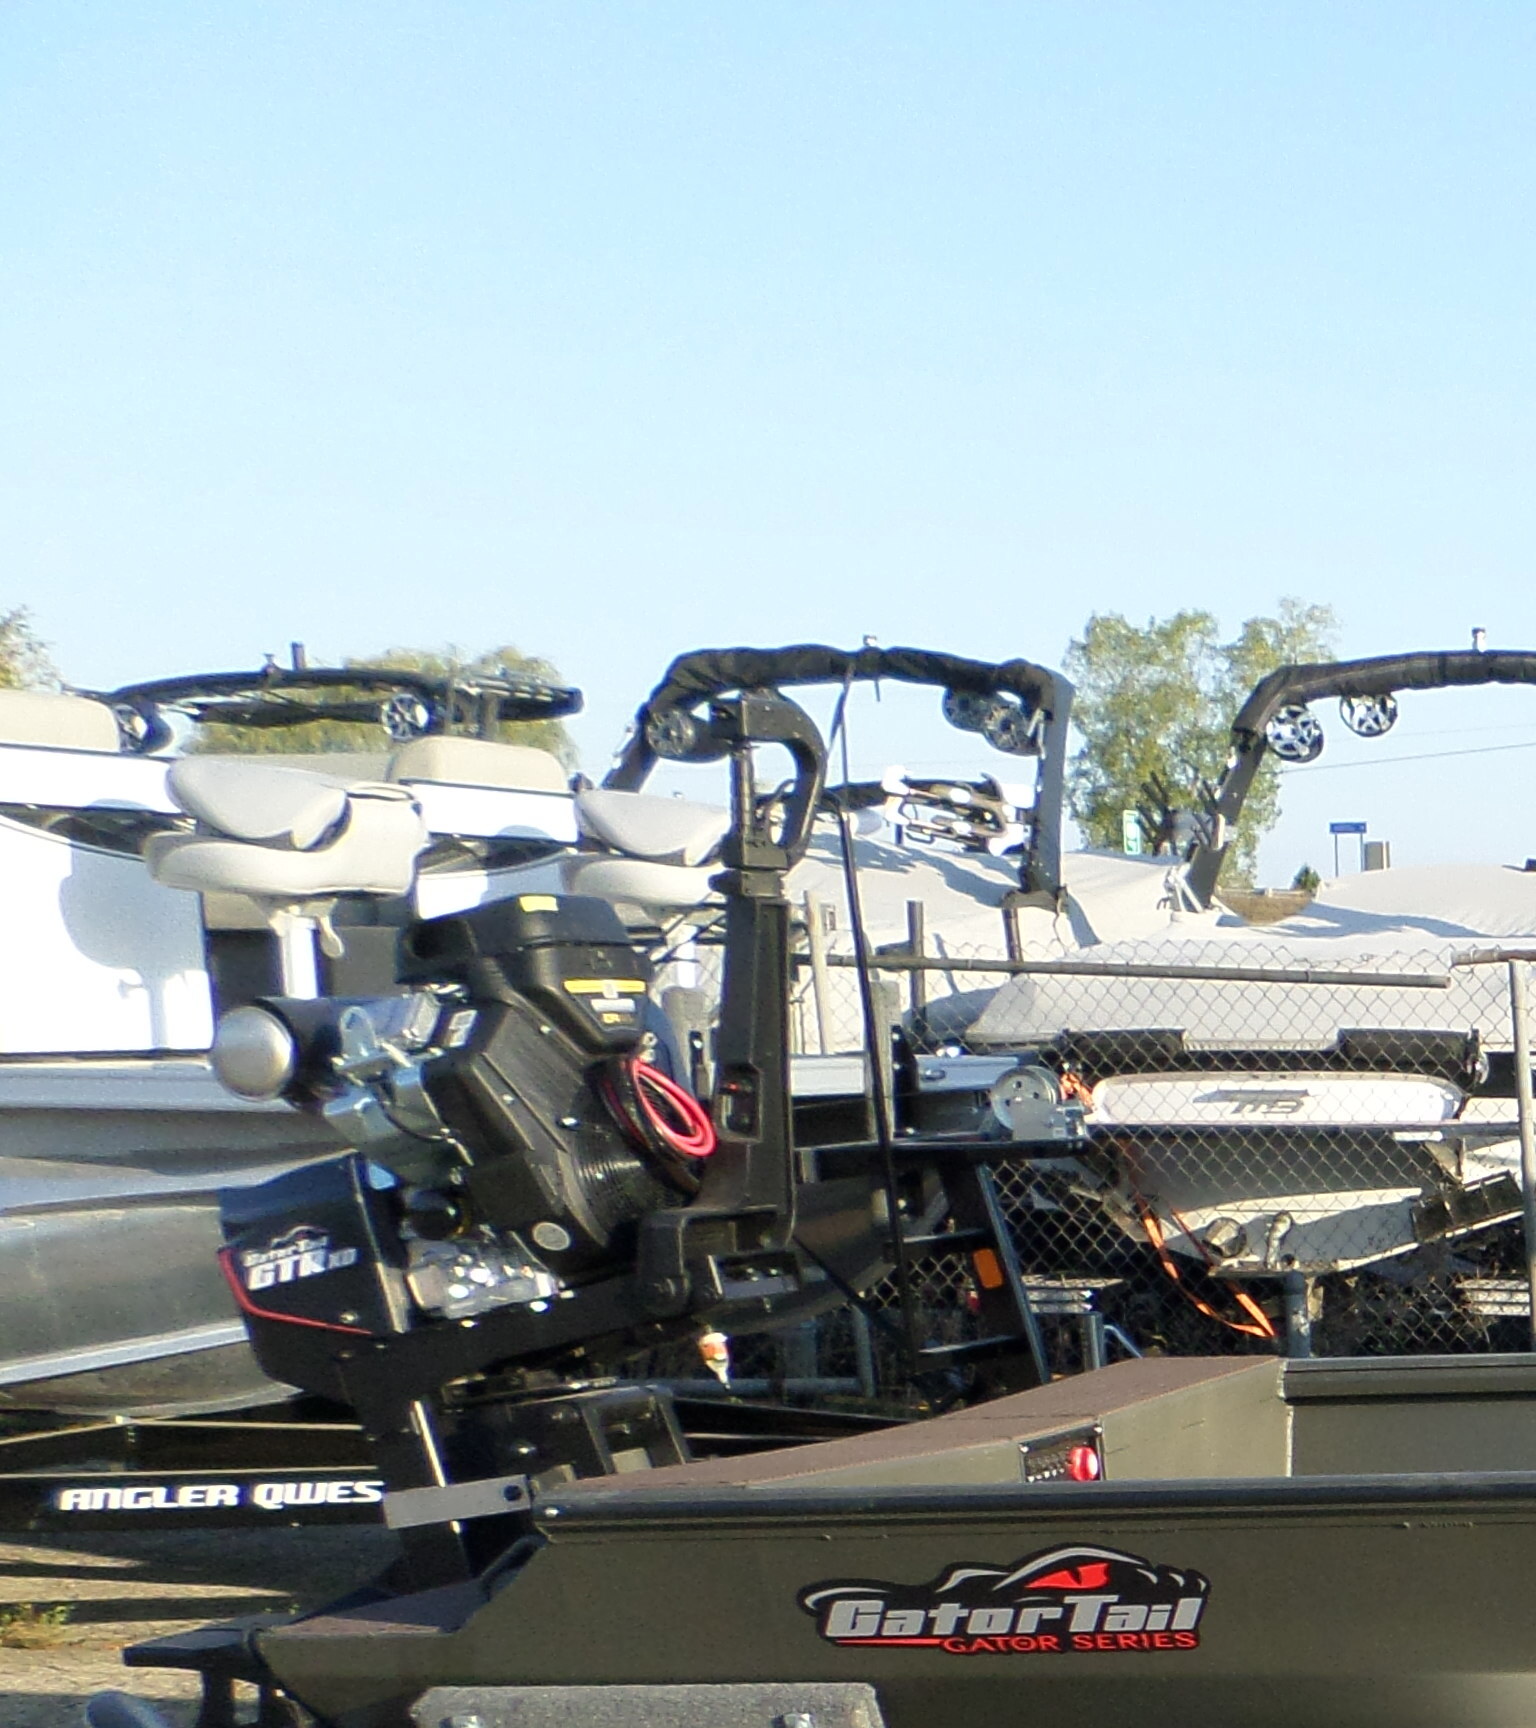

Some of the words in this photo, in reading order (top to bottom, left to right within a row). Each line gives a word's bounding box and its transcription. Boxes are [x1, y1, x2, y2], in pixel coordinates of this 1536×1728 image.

[59, 1484, 240, 1511] ANGLER
[825, 1595, 1203, 1637] GatorTail
[943, 1635, 1061, 1653] GATOR
[1072, 1632, 1197, 1651] SERIES
